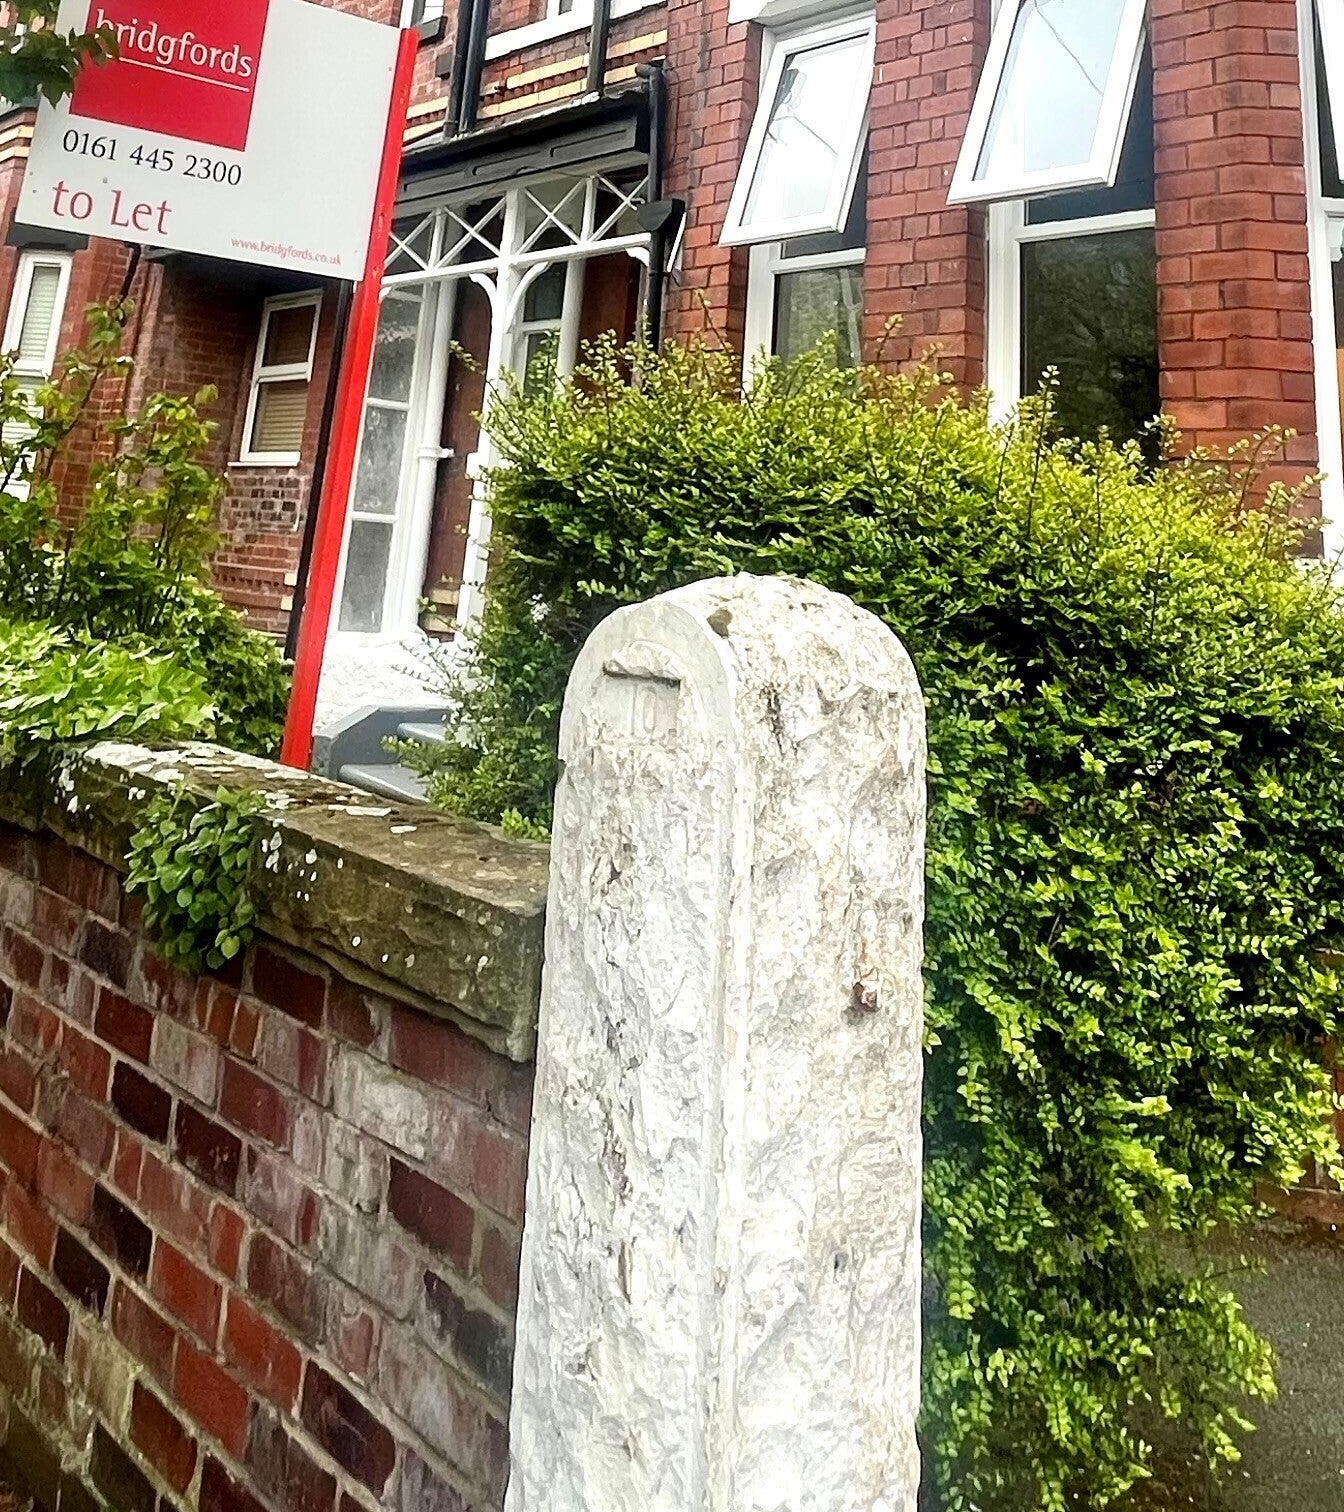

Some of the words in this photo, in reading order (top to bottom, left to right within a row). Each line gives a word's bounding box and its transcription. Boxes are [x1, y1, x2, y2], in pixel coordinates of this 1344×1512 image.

[62, 129, 118, 161] 0161
[128, 144, 175, 172] 445
[182, 154, 243, 186] 2300
[51, 180, 94, 220] to
[109, 189, 173, 236] Let
[230, 238, 342, 265] www.bridgfords.co.uk
